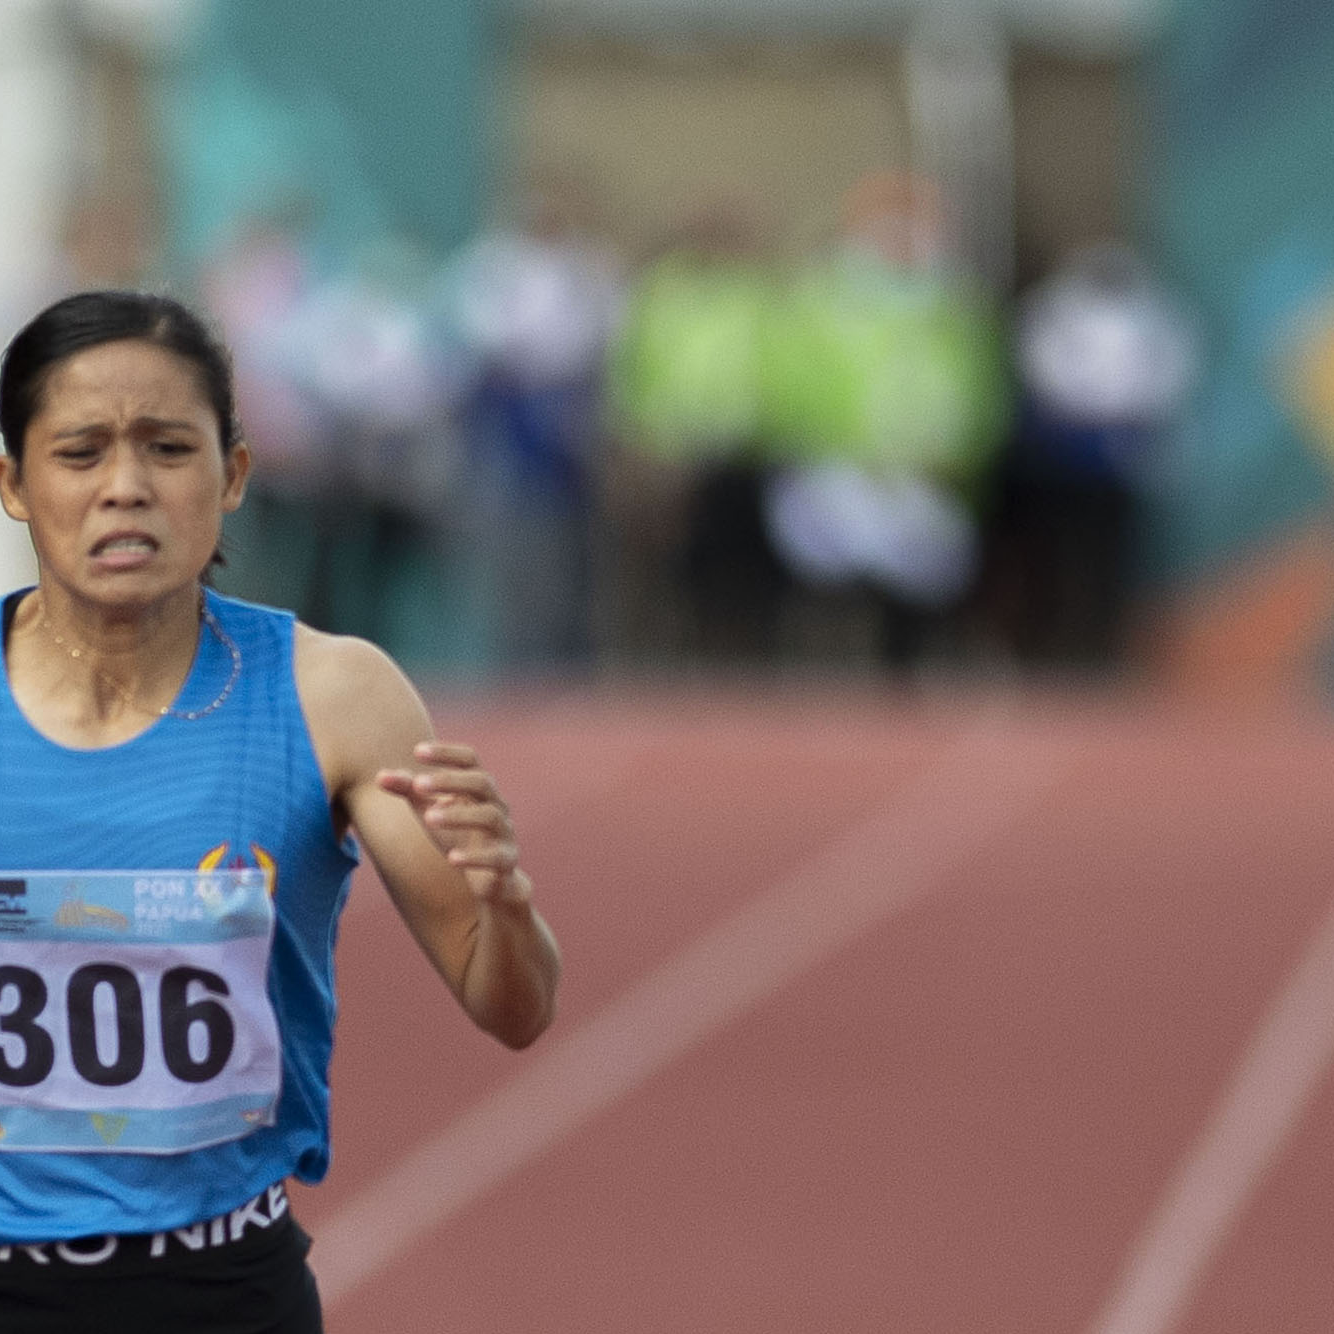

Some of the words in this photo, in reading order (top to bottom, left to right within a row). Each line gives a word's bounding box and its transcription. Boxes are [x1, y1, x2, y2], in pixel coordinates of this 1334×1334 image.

[134, 879, 186, 899] PON
[134, 903, 203, 921] PAPUA
[150, 1184, 289, 1257] NIKE
